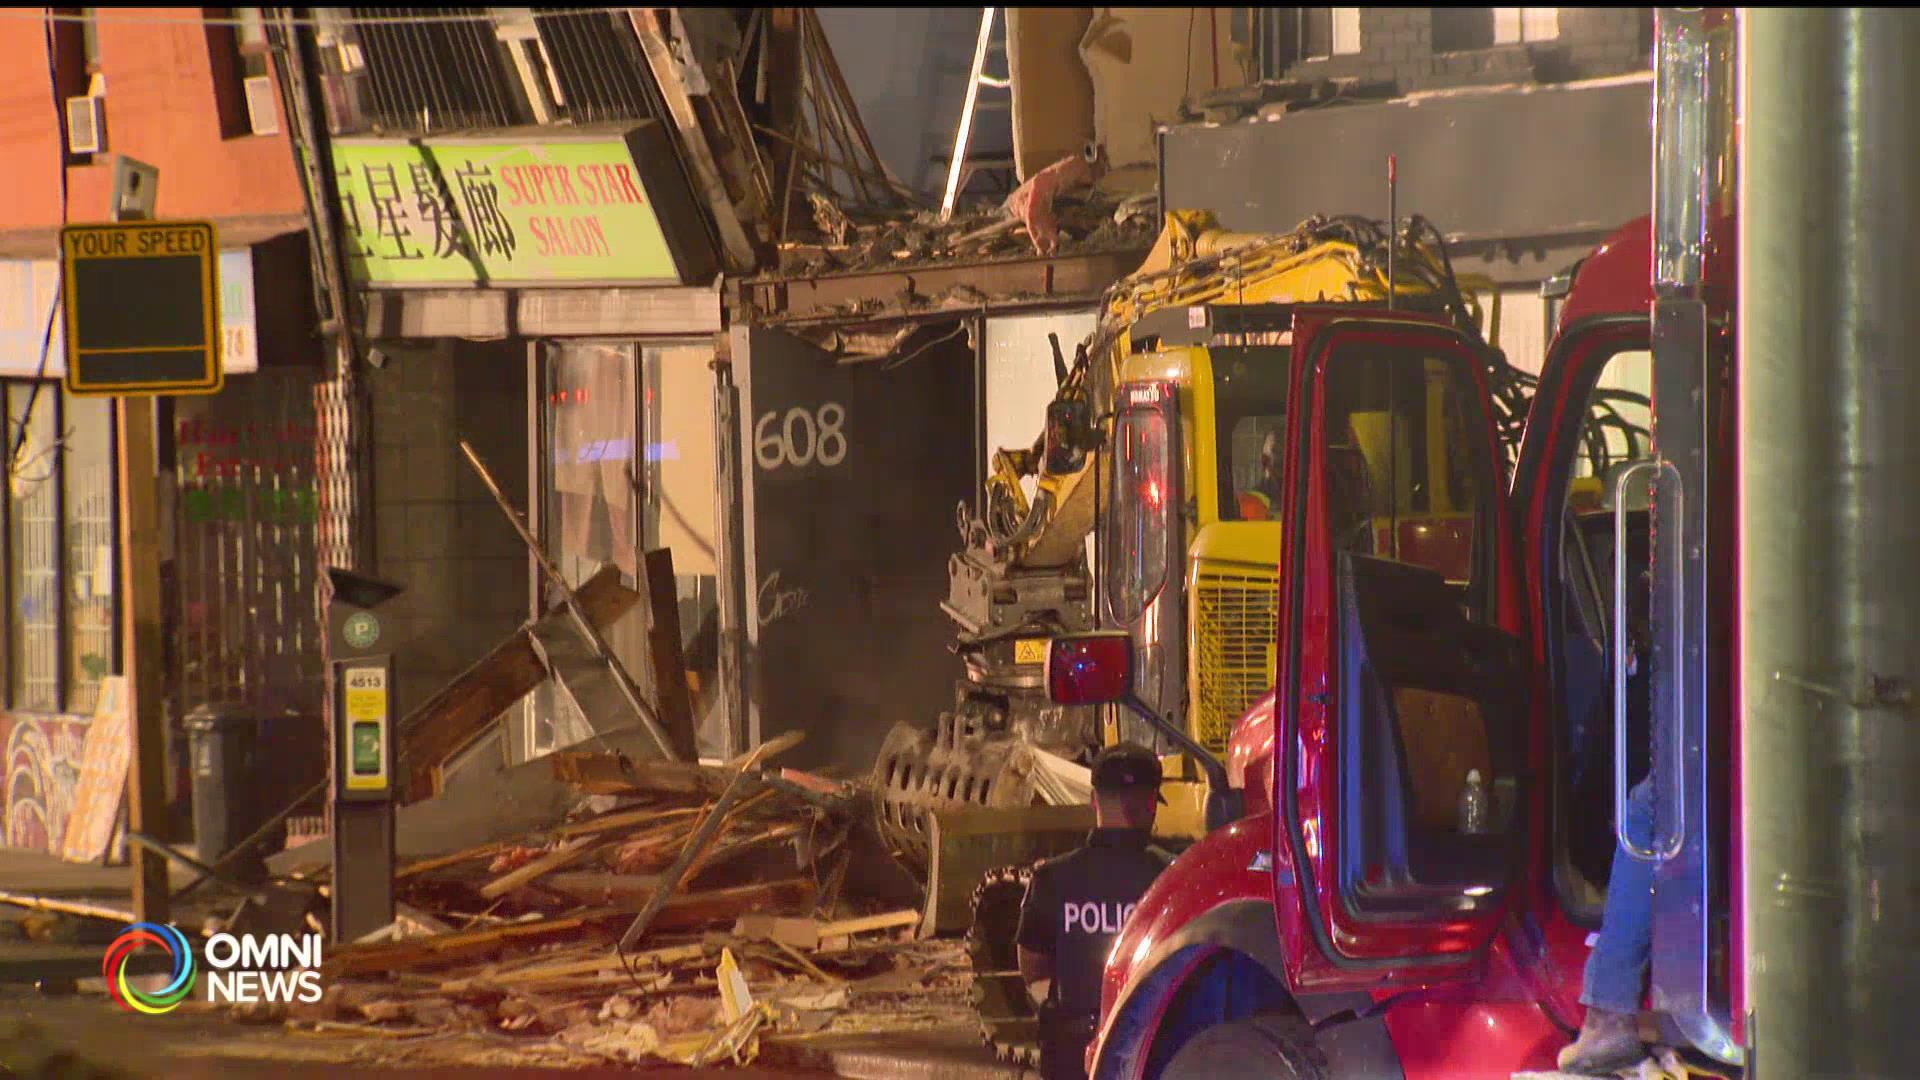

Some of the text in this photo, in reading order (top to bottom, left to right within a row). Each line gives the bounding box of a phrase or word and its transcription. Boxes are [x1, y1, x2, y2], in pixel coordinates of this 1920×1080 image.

[501, 163, 642, 206] SUPER STAR
[70, 229, 206, 255] YOUR SPEED
[529, 213, 612, 258] SALON
[754, 403, 847, 470] 608
[350, 676, 381, 688] 4513
